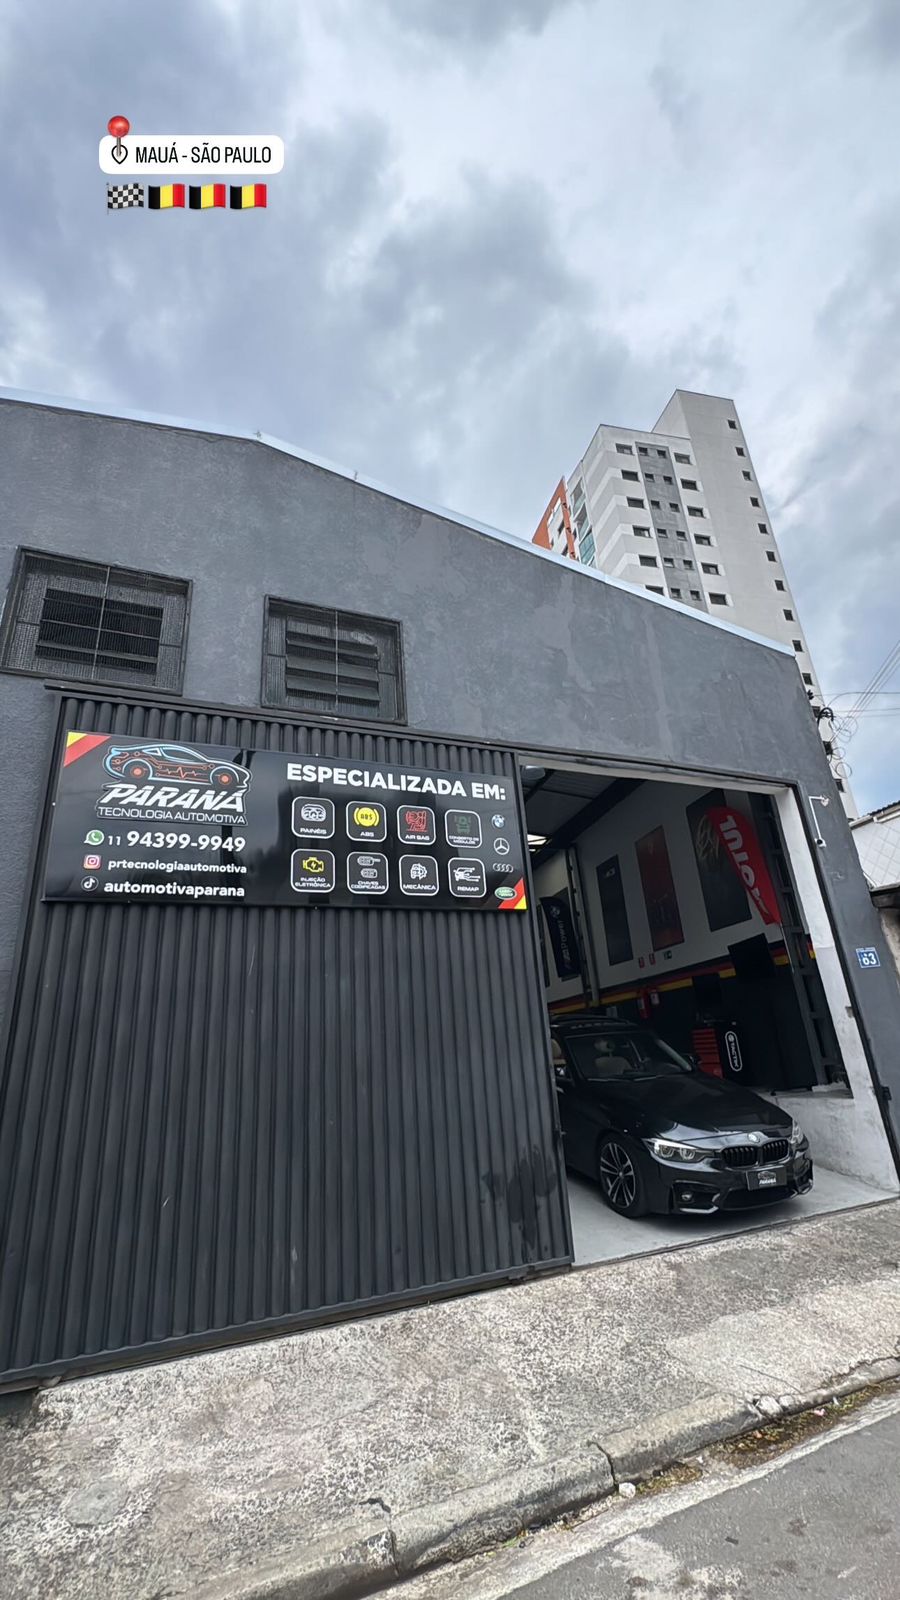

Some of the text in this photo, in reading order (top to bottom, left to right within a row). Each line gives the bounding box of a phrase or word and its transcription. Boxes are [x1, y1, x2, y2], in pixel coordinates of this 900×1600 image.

[286, 762, 506, 801] ESPECIALIZADA EM:
[99, 783, 248, 812] PARANÁ
[98, 806, 246, 824] TECNOLOGIA AUTOMOTIVA
[299, 827, 327, 835] PAINÉIS
[107, 830, 247, 852] 11 94399-9949
[107, 858, 247, 874] prtecnologiaautomotiva
[103, 880, 245, 898] automotivaparana
[300, 876, 326, 884] INJEÇÃO
[862, 952, 877, 966] 63
